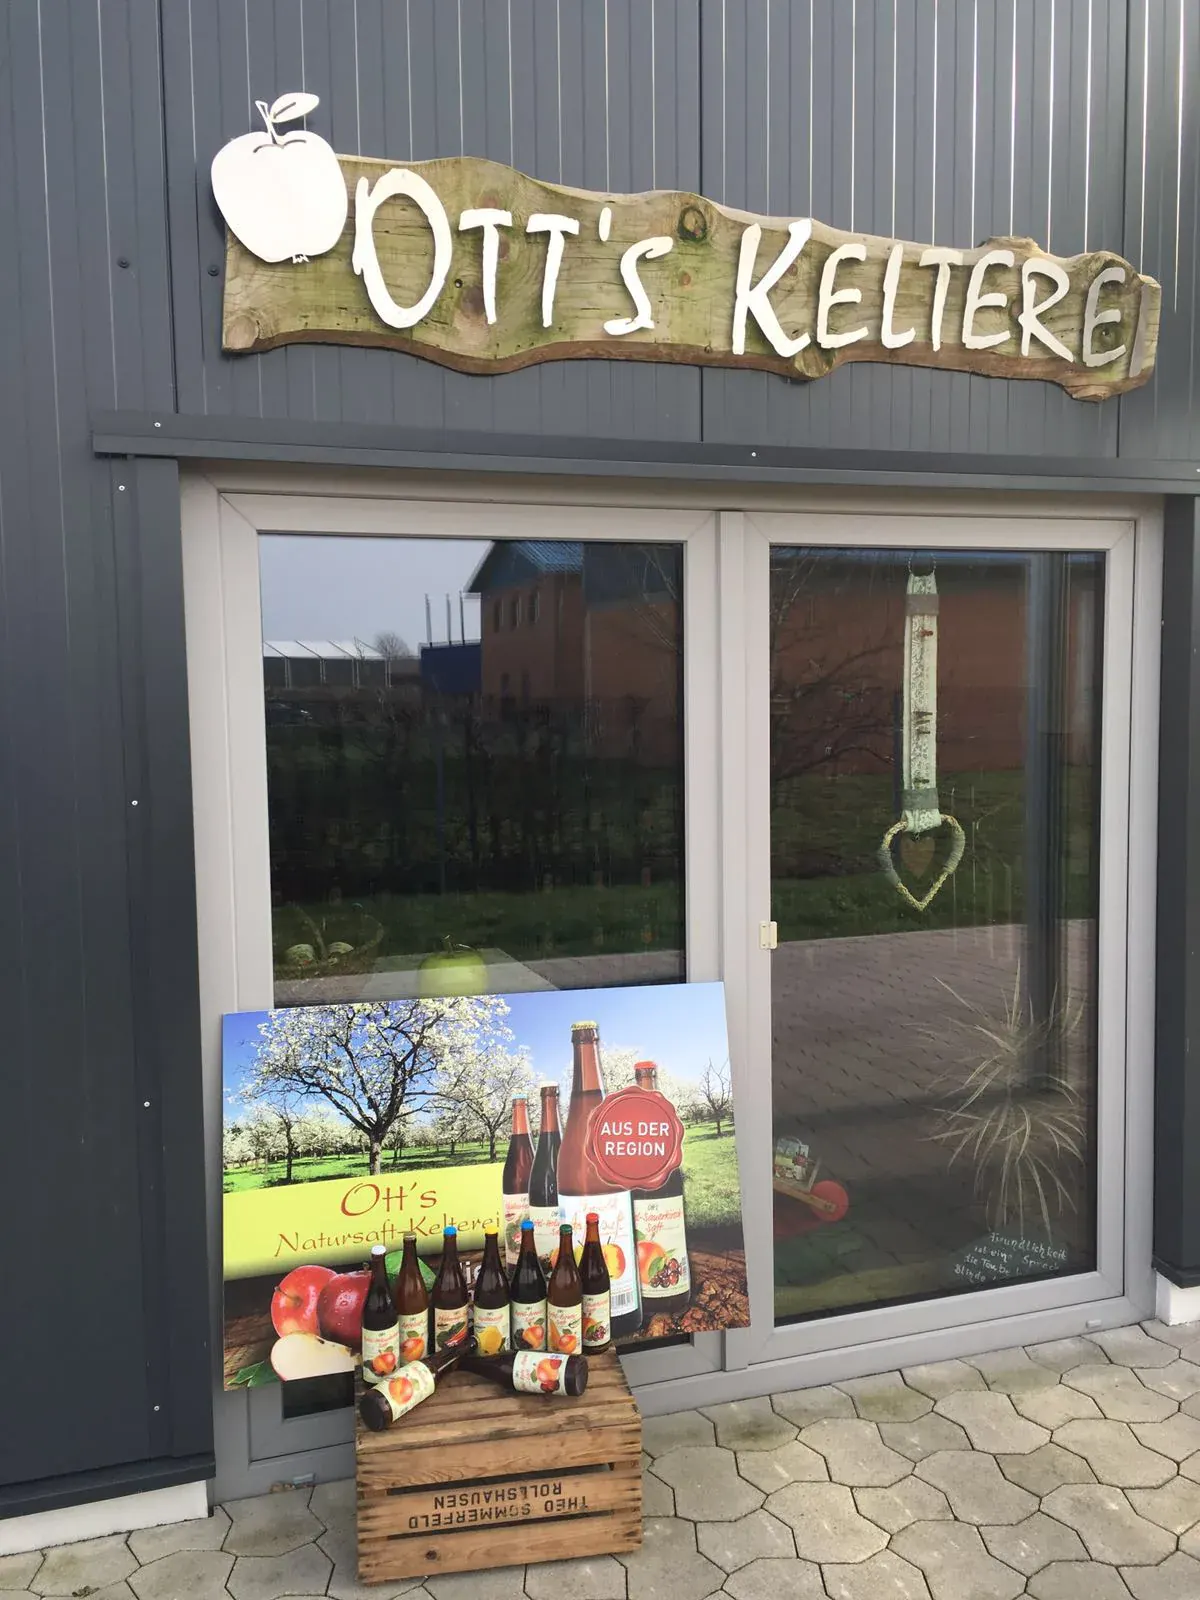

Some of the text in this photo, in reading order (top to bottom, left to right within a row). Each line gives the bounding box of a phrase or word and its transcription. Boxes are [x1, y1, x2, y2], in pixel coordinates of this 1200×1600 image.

[732, 217, 1151, 379] KELTEREI
[601, 1121, 670, 1137] AUS DER
[604, 1141, 666, 1157] REGION
[433, 1481, 563, 1510] ROLLSHAUSEN
[407, 1495, 589, 1530] THEO SOMMERFELD
